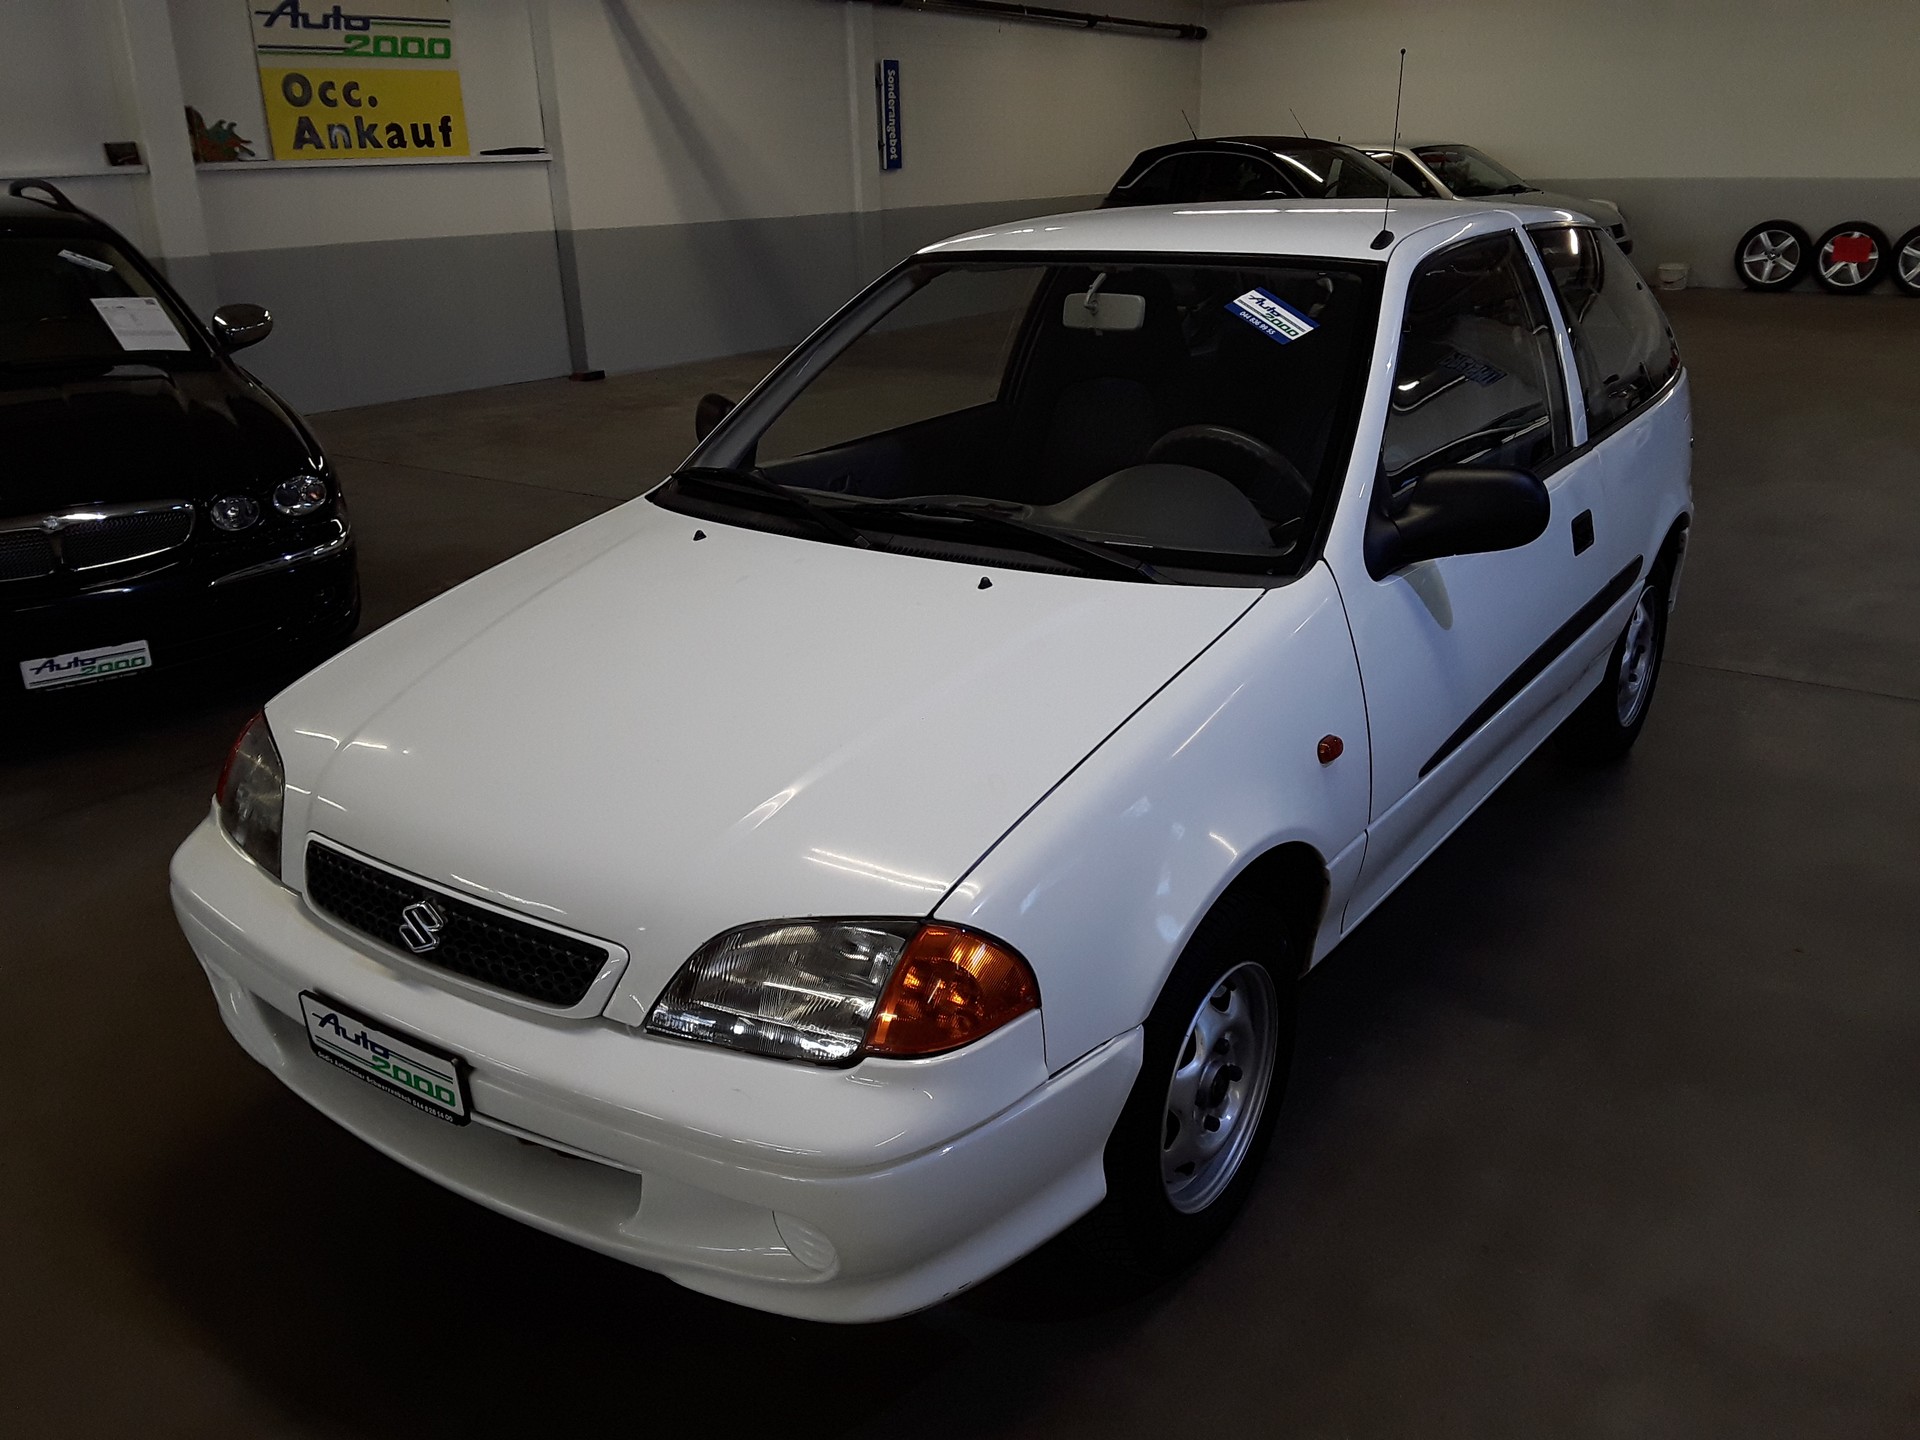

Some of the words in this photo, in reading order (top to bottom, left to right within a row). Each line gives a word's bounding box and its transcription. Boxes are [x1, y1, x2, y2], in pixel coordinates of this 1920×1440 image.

[263, 0, 371, 31] Auto
[344, 34, 451, 59] 2000
[282, 72, 378, 108] Occ.
[887, 69, 898, 160] Sonderangebot
[292, 115, 453, 150] Ankauf
[1248, 294, 1281, 317] Auto
[1264, 313, 1300, 337] 2000
[31, 657, 97, 675] Auto
[81, 656, 146, 676] 2000
[318, 1013, 390, 1059] Auto
[371, 1054, 456, 1106] 2000
